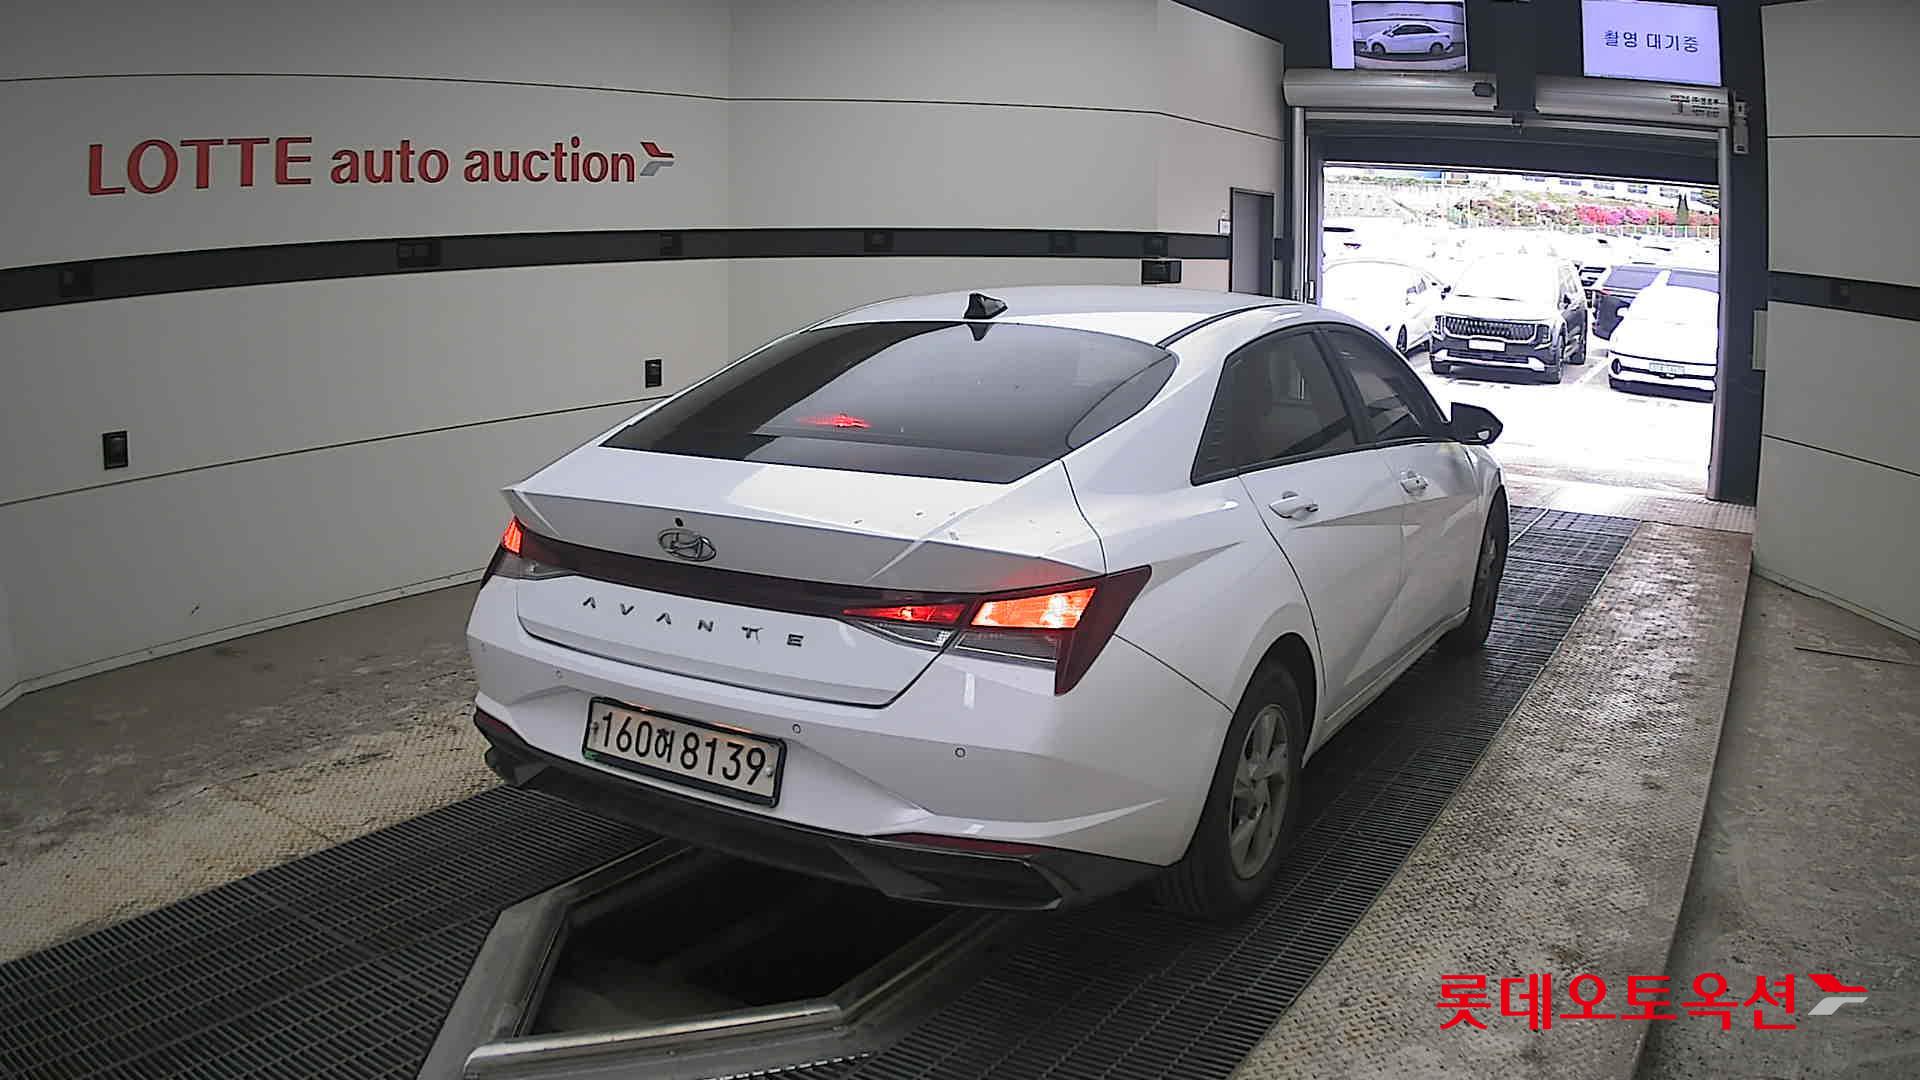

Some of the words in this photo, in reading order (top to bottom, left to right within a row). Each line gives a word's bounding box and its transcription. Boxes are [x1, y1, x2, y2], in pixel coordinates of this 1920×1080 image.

[1646, 33, 1698, 53] 대기중
[88, 136, 312, 196] LOTTE
[329, 139, 449, 184] auto
[463, 136, 636, 184] auction
[582, 596, 804, 647] AVANTE
